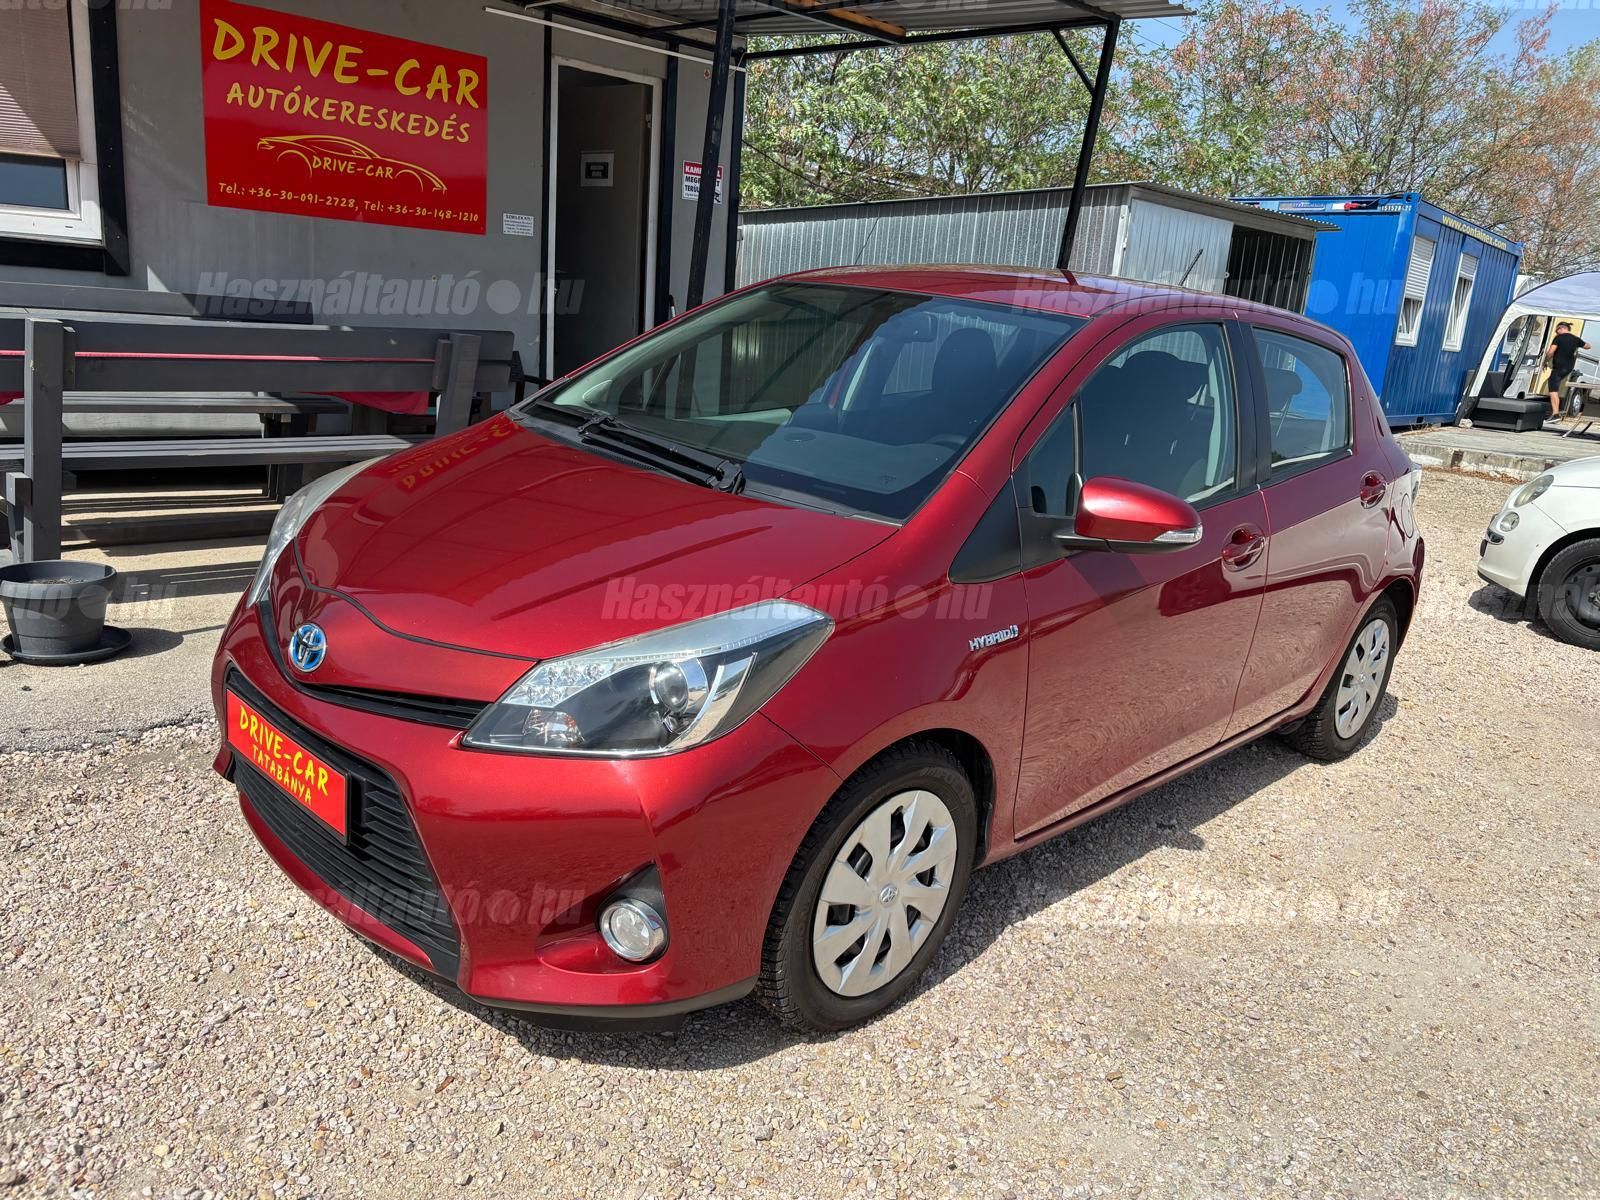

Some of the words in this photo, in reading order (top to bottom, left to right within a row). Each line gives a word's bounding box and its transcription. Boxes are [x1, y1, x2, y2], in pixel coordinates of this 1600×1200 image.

[212, 18, 479, 108] DRIVE-CAR
[226, 82, 471, 143] AUTÓKERESKEDÉS
[312, 155, 394, 179] DRIVE-CAR
[218, 182, 245, 195] Tel.:
[249, 187, 359, 212] +36-30-091-2728,
[364, 200, 384, 212] Tel:
[387, 204, 479, 222] +36-30-148-1210
[1442, 215, 1507, 250] www.containex.com
[969, 629, 1011, 651] HYBRID
[239, 705, 329, 796] DRIVE-CAR
[252, 744, 312, 805] TATABÁNYA
